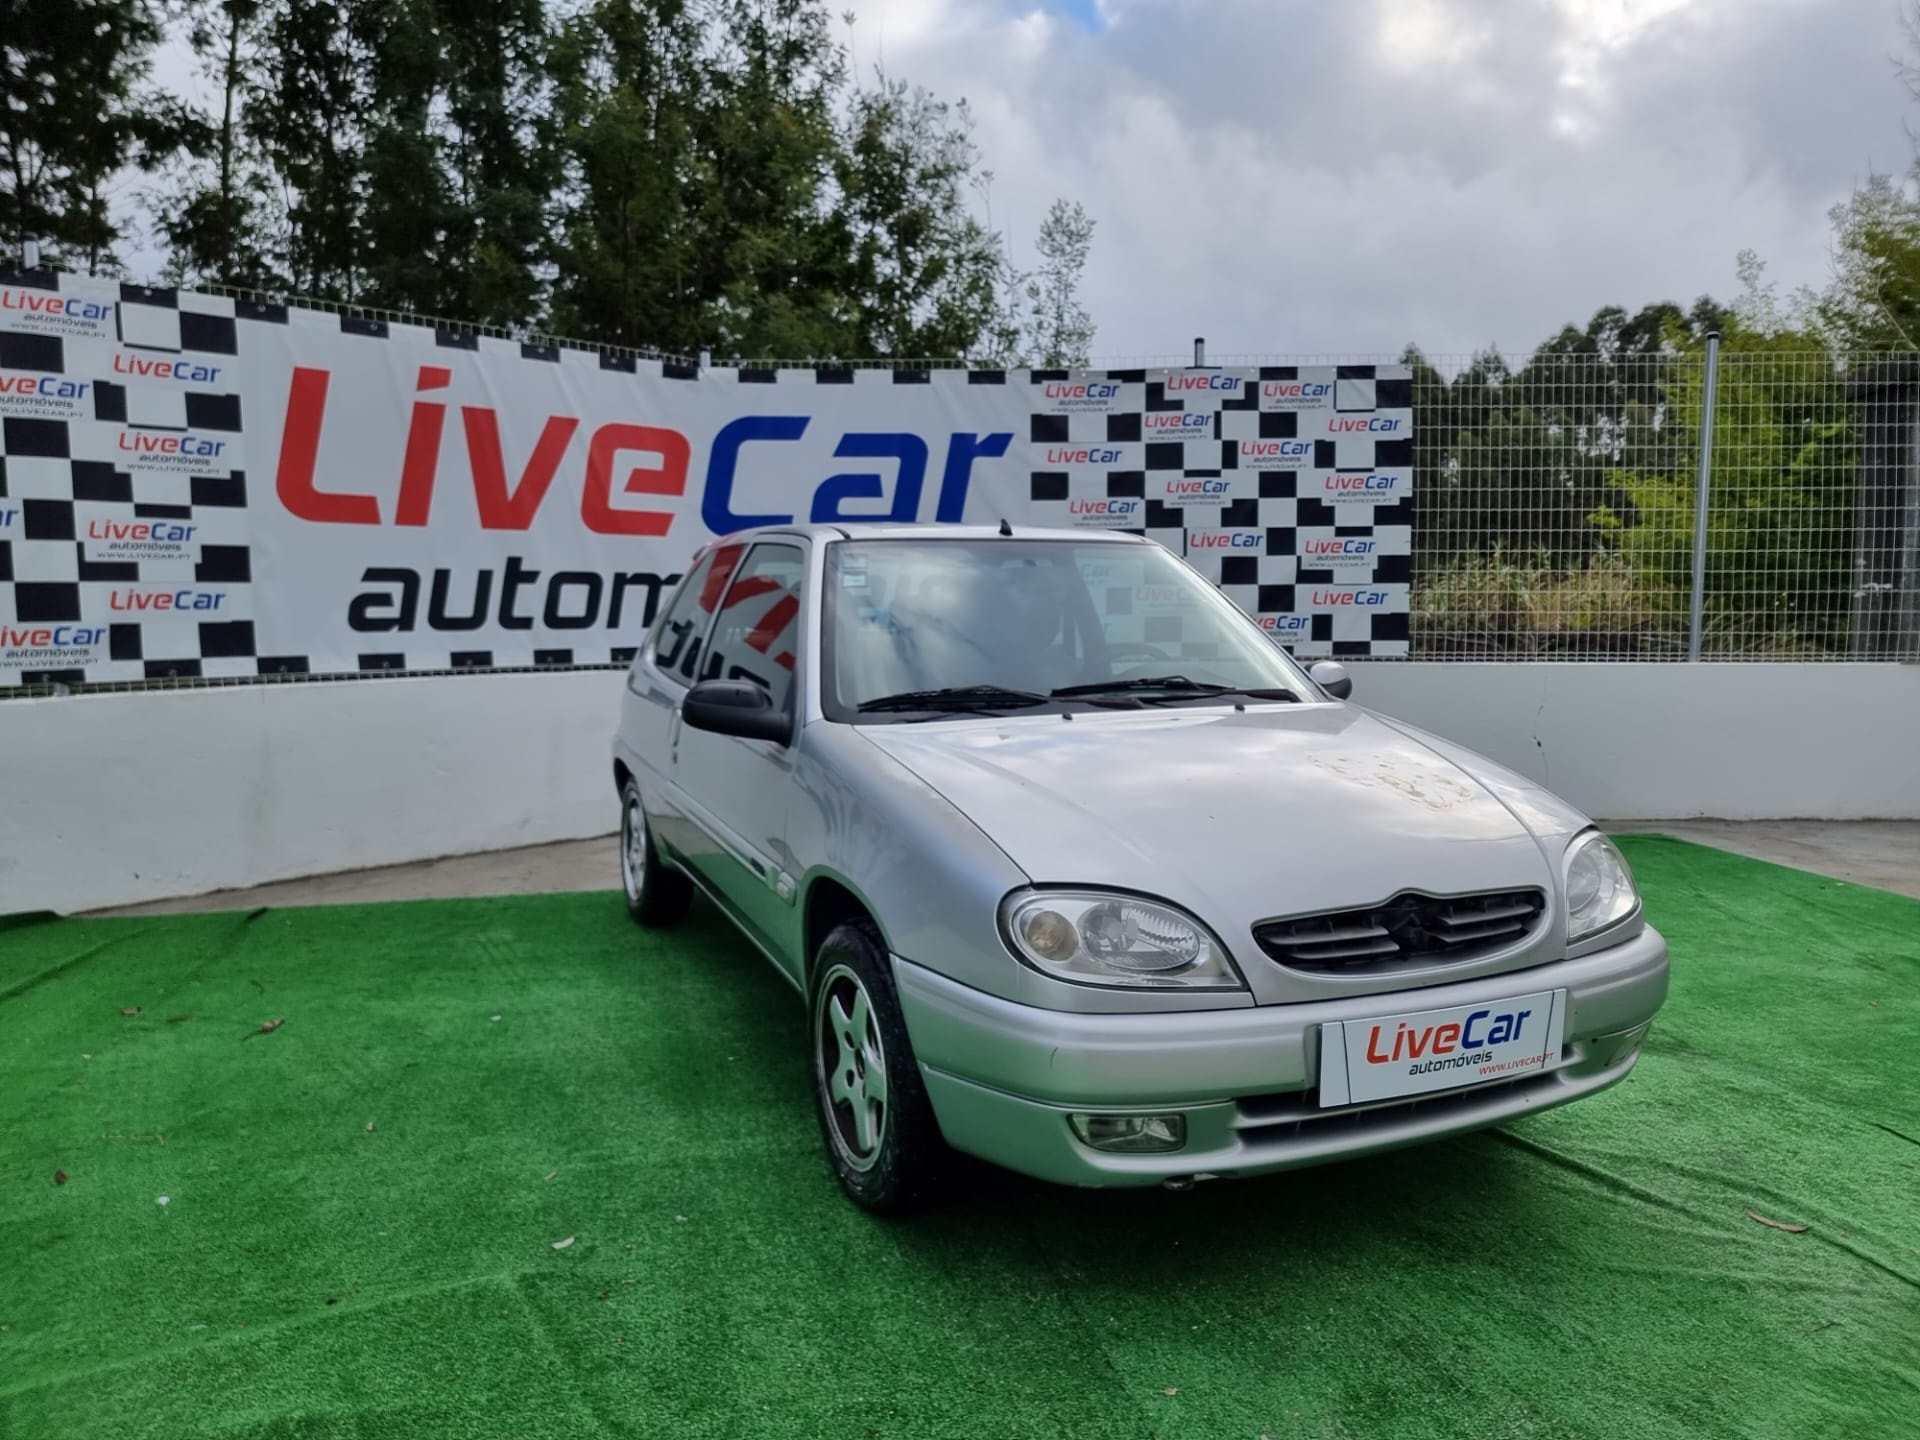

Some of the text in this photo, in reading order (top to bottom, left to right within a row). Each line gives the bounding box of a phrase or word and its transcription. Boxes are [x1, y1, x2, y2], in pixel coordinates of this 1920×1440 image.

[2, 290, 113, 321] LiveCar
[113, 354, 222, 383] LiveCar
[0, 377, 90, 399] veCar
[1167, 374, 1242, 390] LiveCar
[1264, 382, 1332, 397] LiveCar
[1045, 383, 1120, 398] LiveCar
[1144, 412, 1212, 428] LiveCar
[1328, 417, 1402, 432] LiveCar
[119, 431, 226, 457] LiveCar
[275, 364, 1015, 537] LiveCar
[1241, 441, 1312, 455] LiveCar
[1047, 448, 1123, 463] LiveCar
[1166, 480, 1231, 494] LiveCar
[1325, 475, 1398, 490] LiveCar
[1069, 500, 1139, 514] LiveCar
[89, 520, 197, 542] LiveCar
[1190, 533, 1264, 548] LiveCar
[1305, 539, 1376, 554] LiveCar
[110, 588, 226, 611] LiveCar
[1312, 590, 1389, 605] LiveCar
[0, 625, 107, 647] iveCar
[1366, 1009, 1532, 1065] LiveCar
[1408, 1050, 1493, 1076] automóveis
